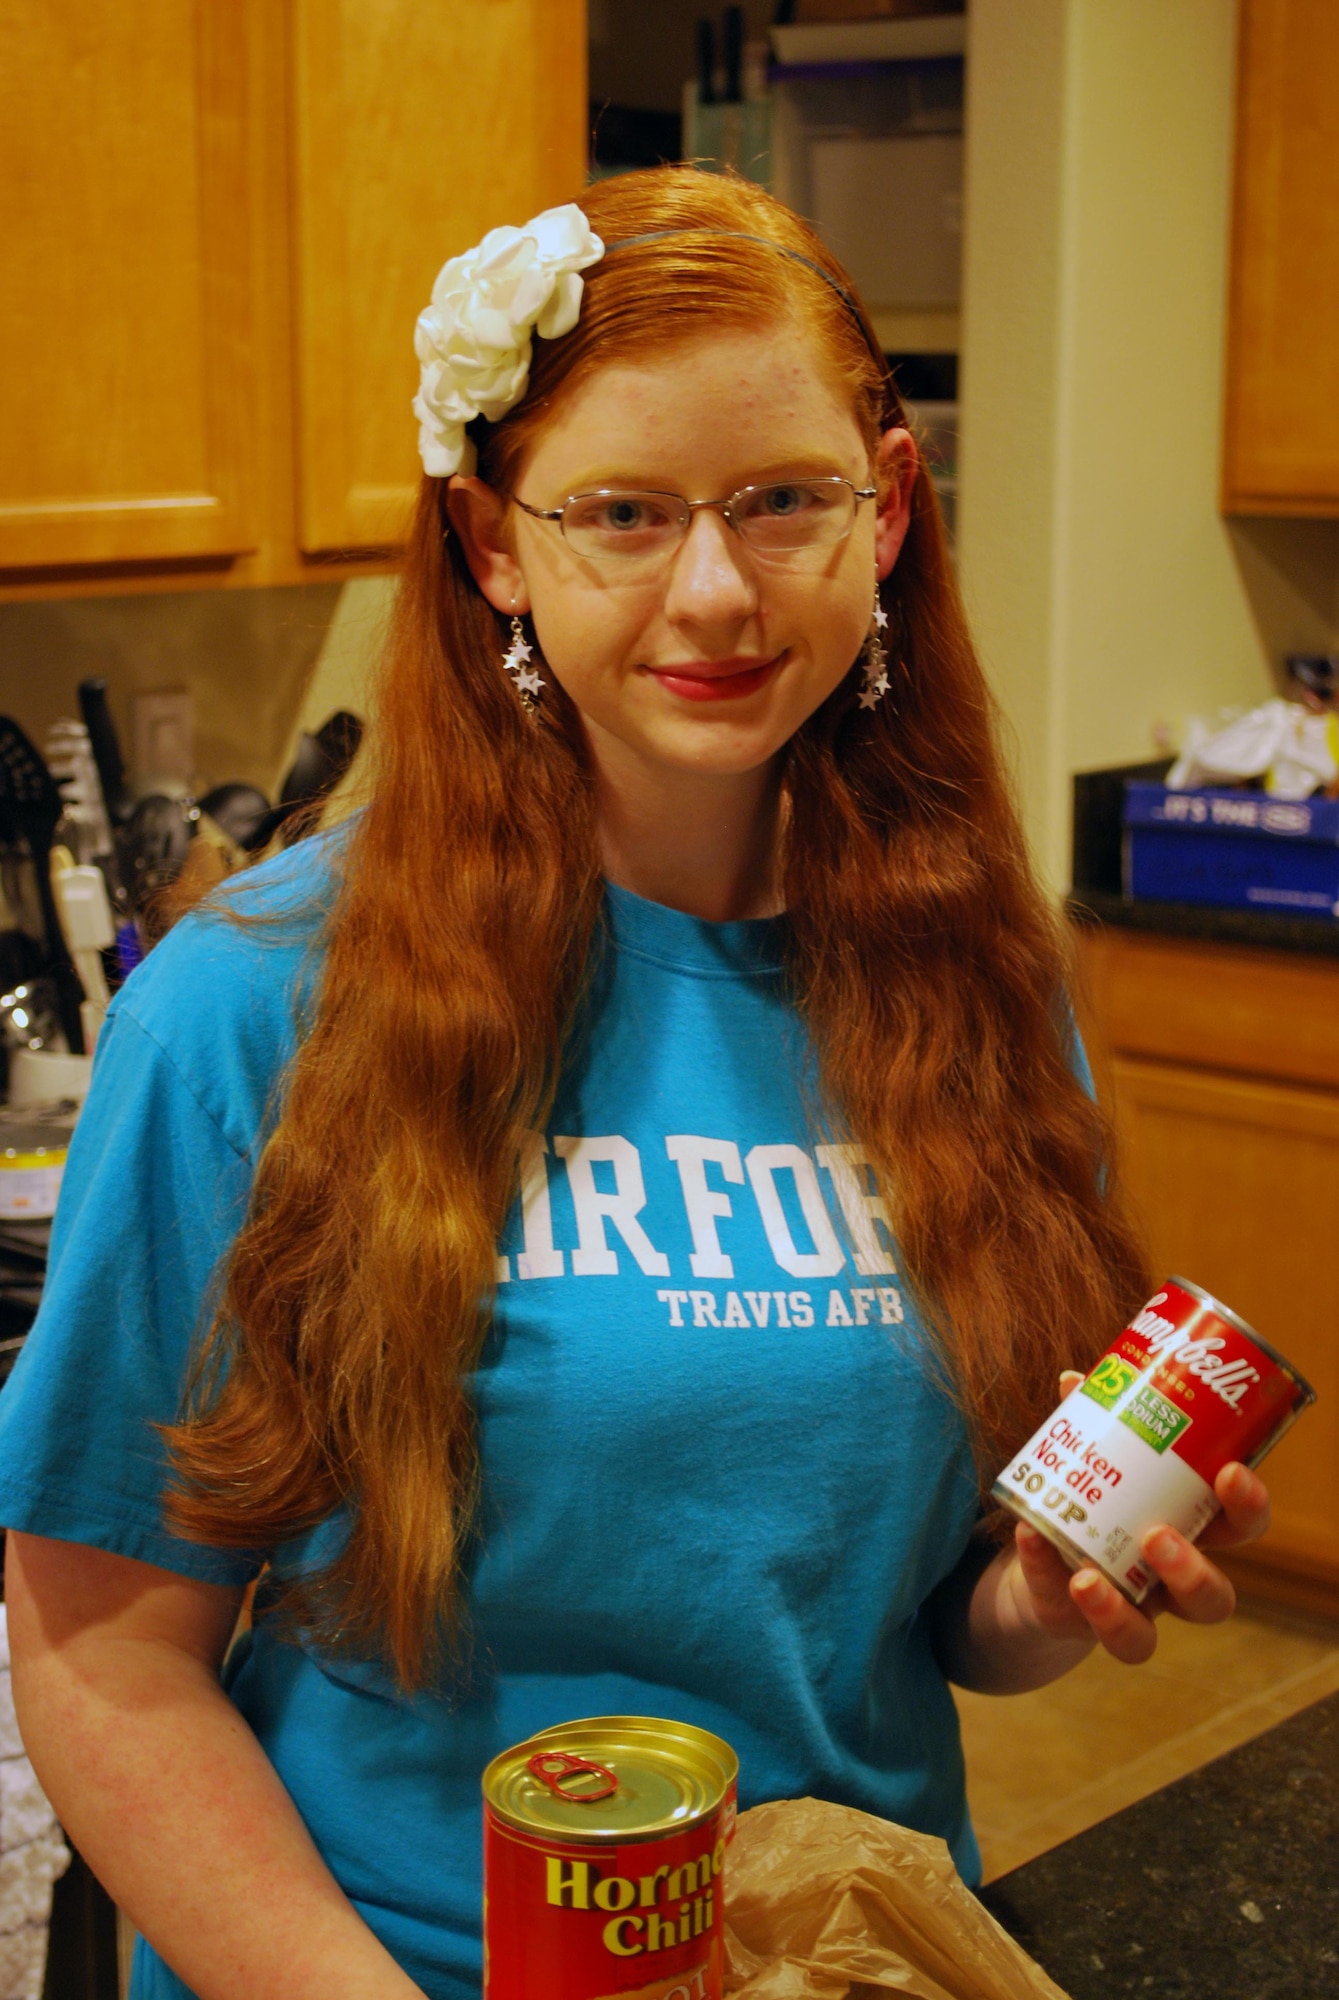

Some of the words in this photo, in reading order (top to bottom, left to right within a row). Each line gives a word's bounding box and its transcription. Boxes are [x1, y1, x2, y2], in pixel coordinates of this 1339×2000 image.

[497, 1129, 671, 1283] IR
[657, 1289, 815, 1328] TRAVIS
[825, 1287, 905, 1327] AFB
[1090, 1354, 1143, 1397] 25
[1121, 1341, 1196, 1402] CONDNSED
[1140, 1389, 1181, 1428] LESS
[1049, 1418, 1123, 1488] Chicken
[1012, 1462, 1088, 1524] SOUP
[602, 1888, 714, 1956] Chili
